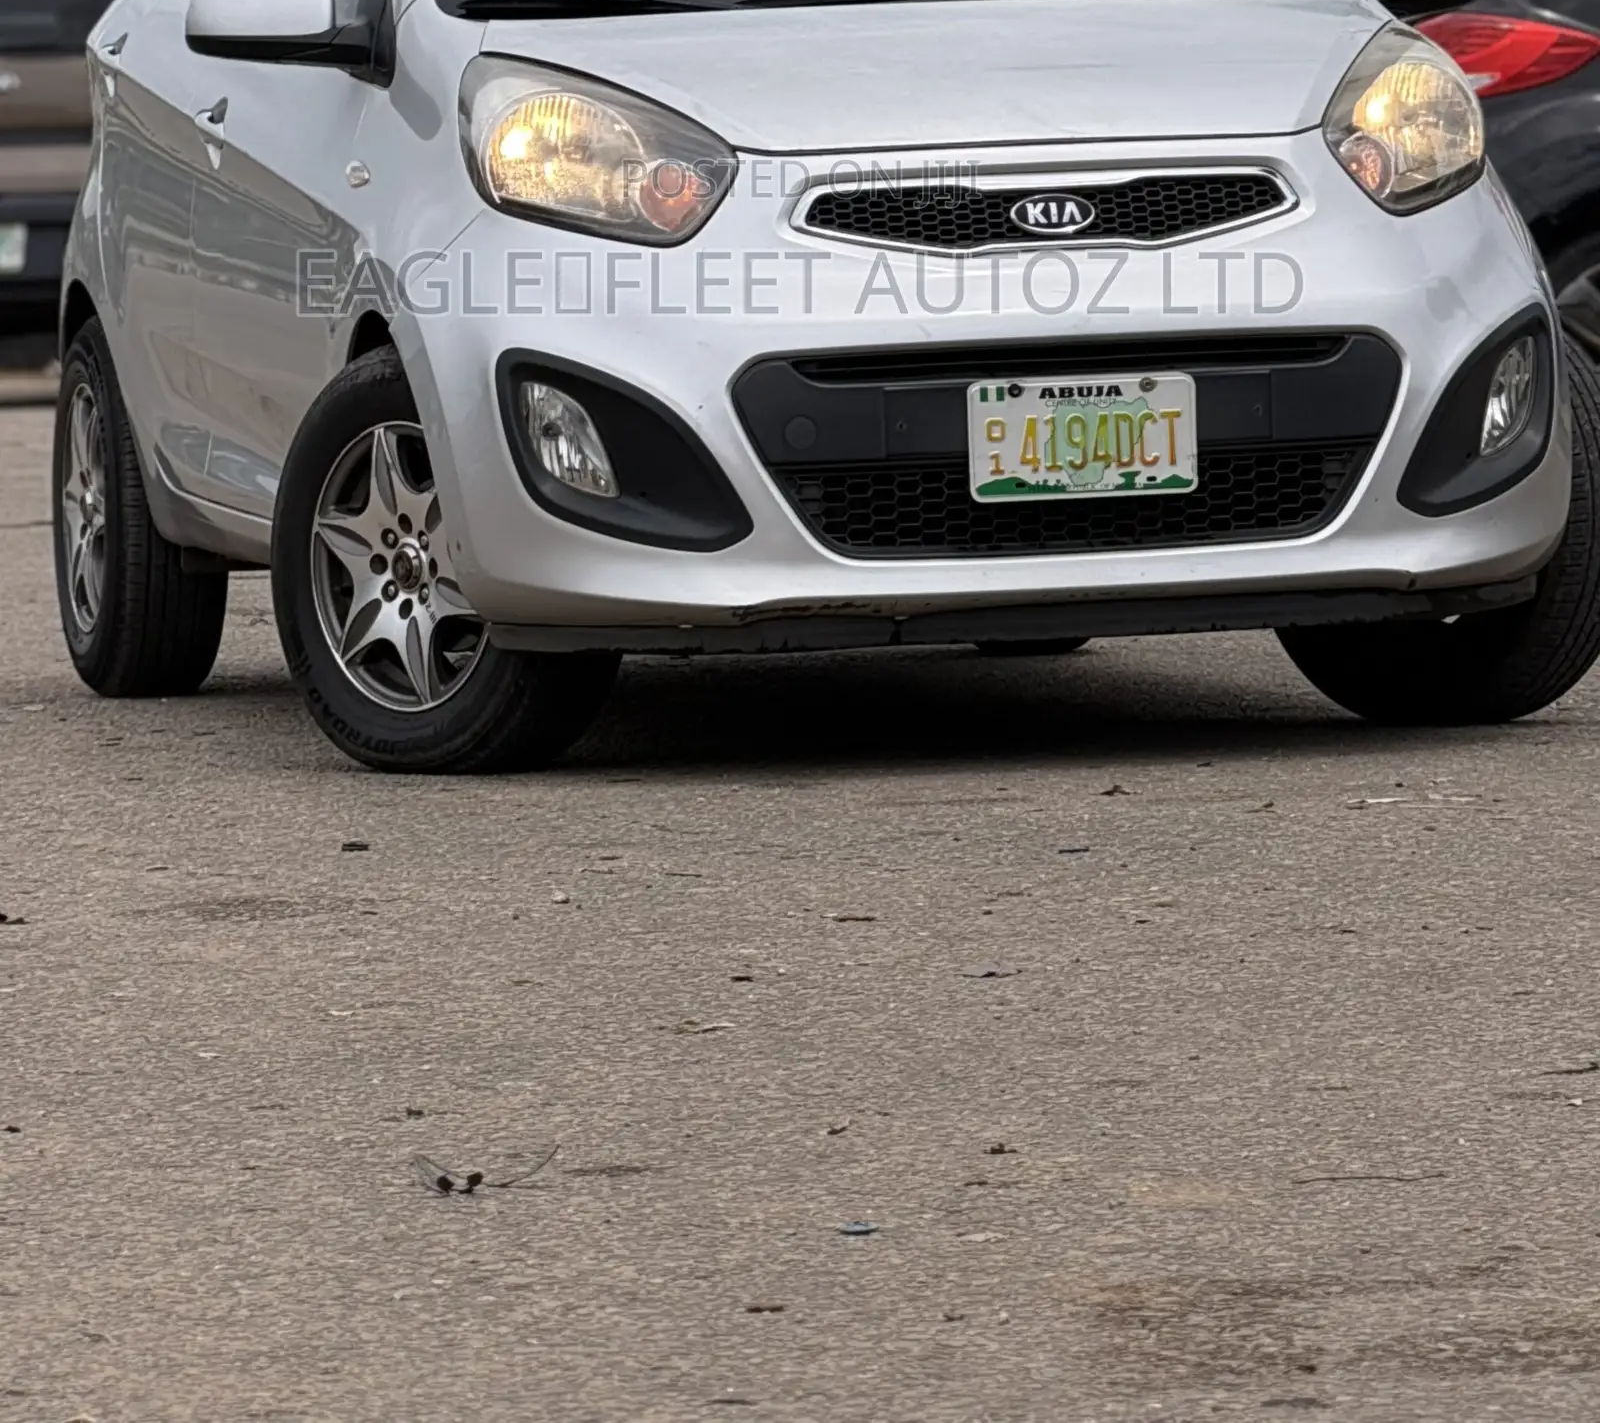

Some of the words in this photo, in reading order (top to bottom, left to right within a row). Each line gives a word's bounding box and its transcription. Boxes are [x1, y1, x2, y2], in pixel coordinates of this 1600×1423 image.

[1025, 202, 1084, 224] KIA
[1039, 385, 1123, 399] ABUJA
[1019, 408, 1182, 473] 4194DCT
